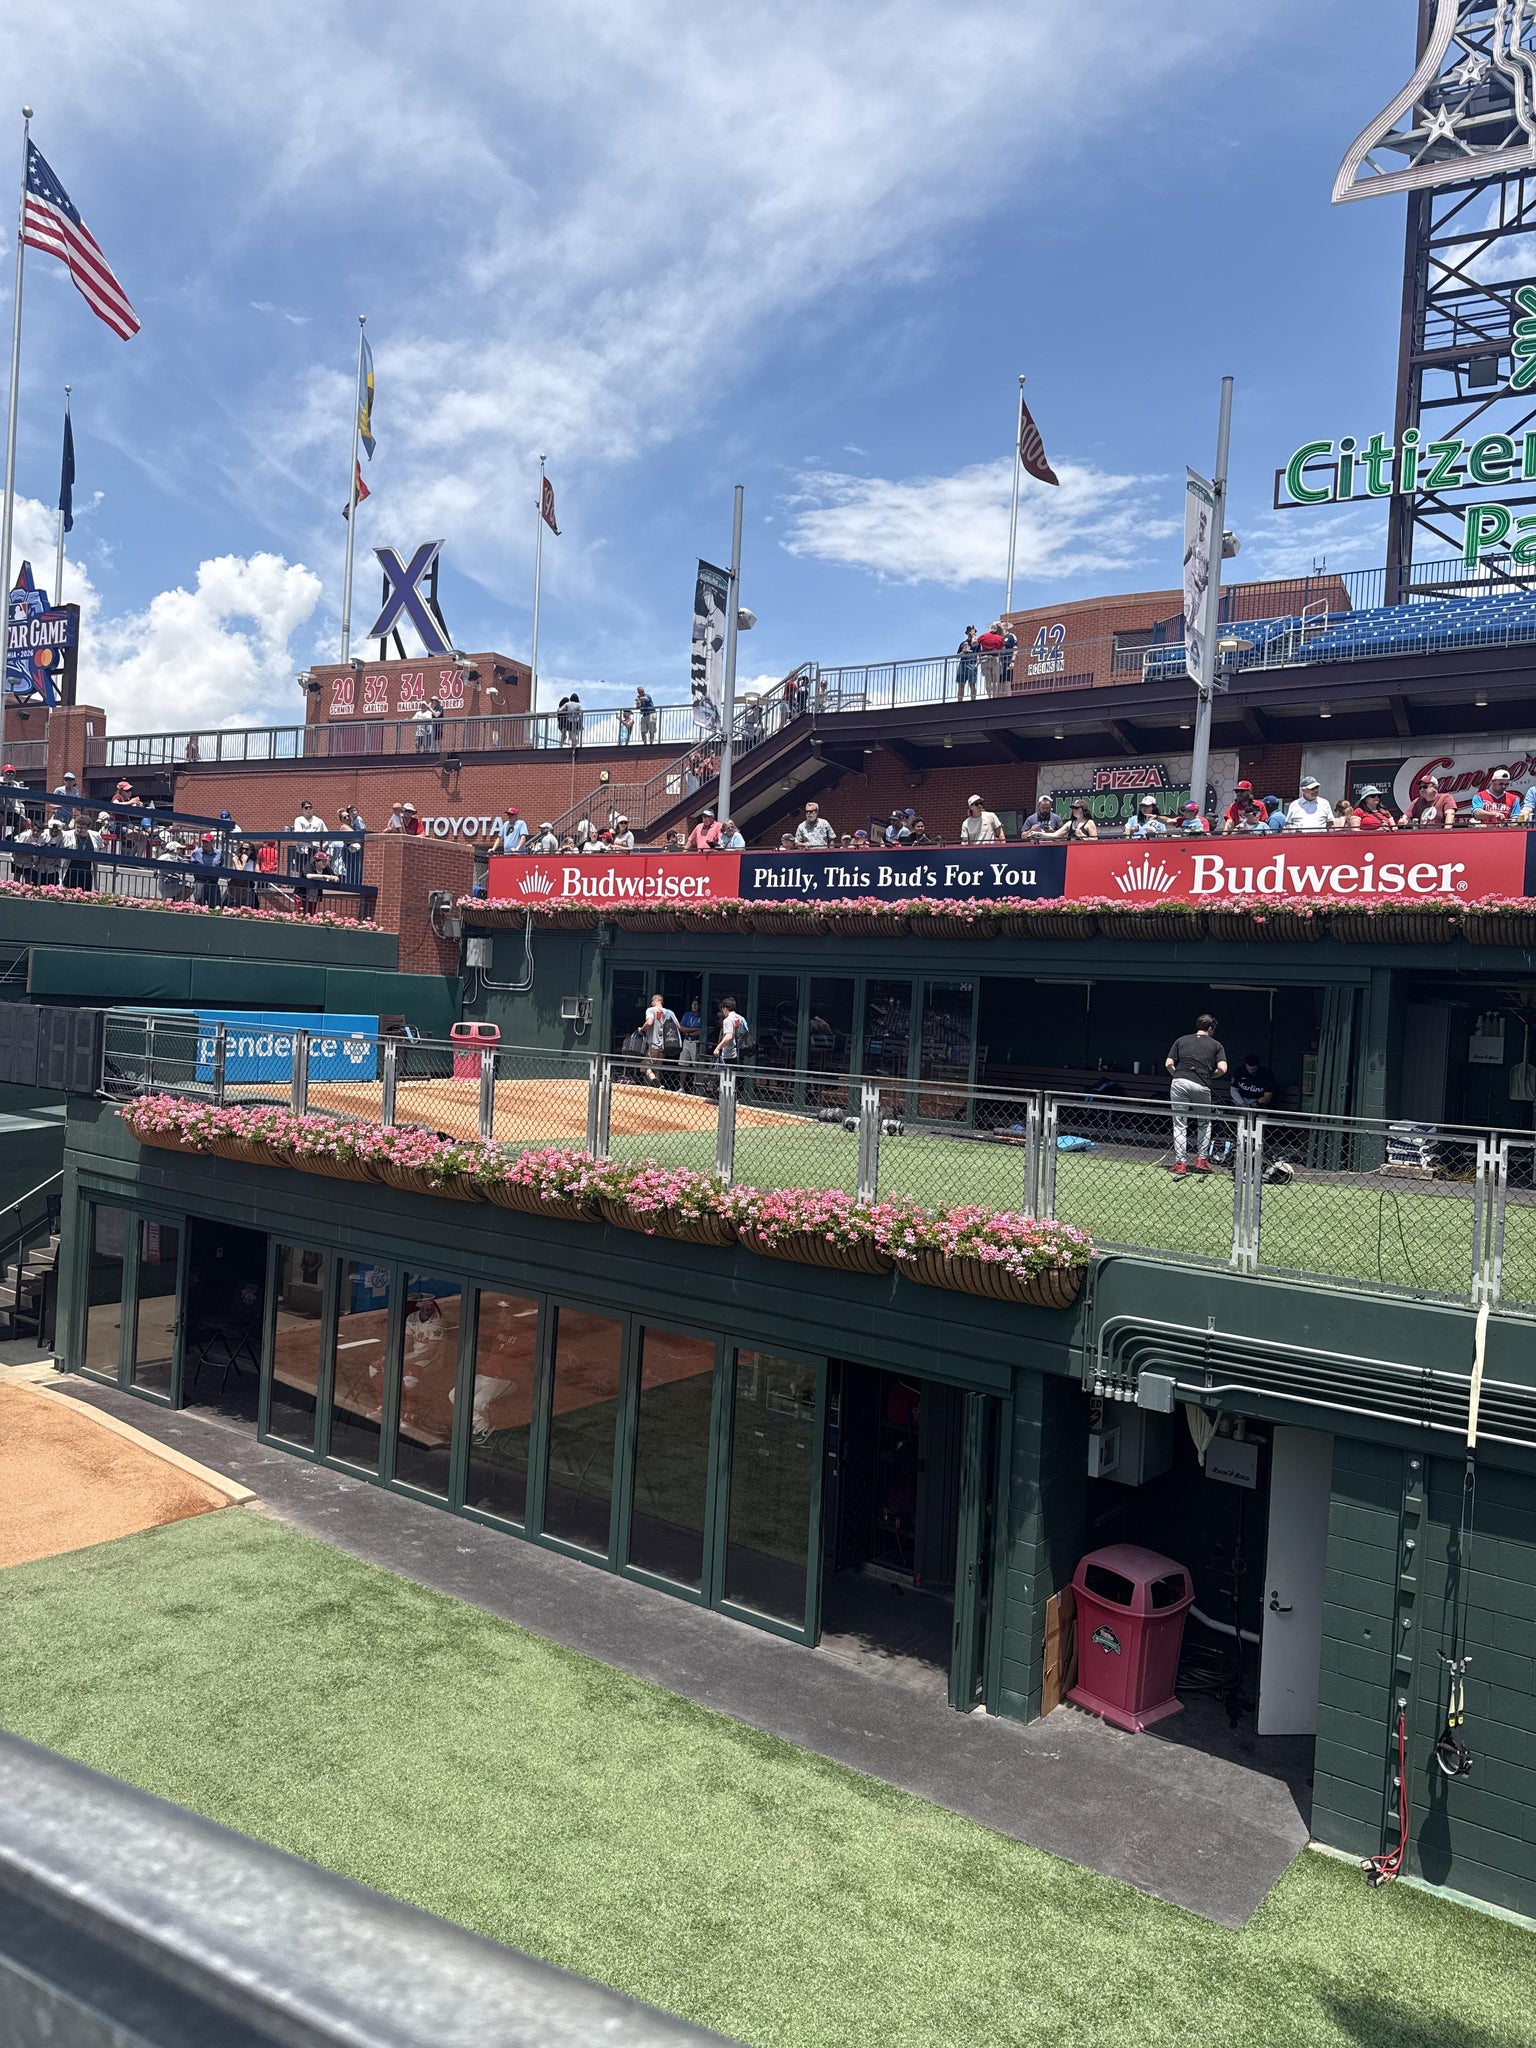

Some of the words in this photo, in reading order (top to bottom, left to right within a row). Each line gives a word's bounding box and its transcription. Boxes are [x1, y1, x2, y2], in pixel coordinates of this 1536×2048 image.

[366, 539, 454, 656] X
[30, 619, 68, 648] GAME
[1031, 624, 1066, 662] 42
[20, 649, 34, 658] 2026
[332, 678, 355, 705] 20
[364, 676, 388, 703] 32
[400, 673, 424, 702] 34
[439, 670, 464, 699] 36
[330, 703, 355, 715] SCHMIDT
[363, 702, 388, 713] CARLTON
[439, 699, 464, 709] OBERTS
[1096, 768, 1163, 791] PIZZA
[1120, 793, 1134, 818] &
[422, 816, 504, 837] TOYOTA
[561, 868, 711, 898] Budweiser
[753, 868, 819, 893] Philly,
[823, 866, 871, 888] This
[876, 865, 938, 887] Bud's
[943, 864, 984, 886] For
[990, 863, 1037, 886] You
[1188, 852, 1466, 894] Budweiser
